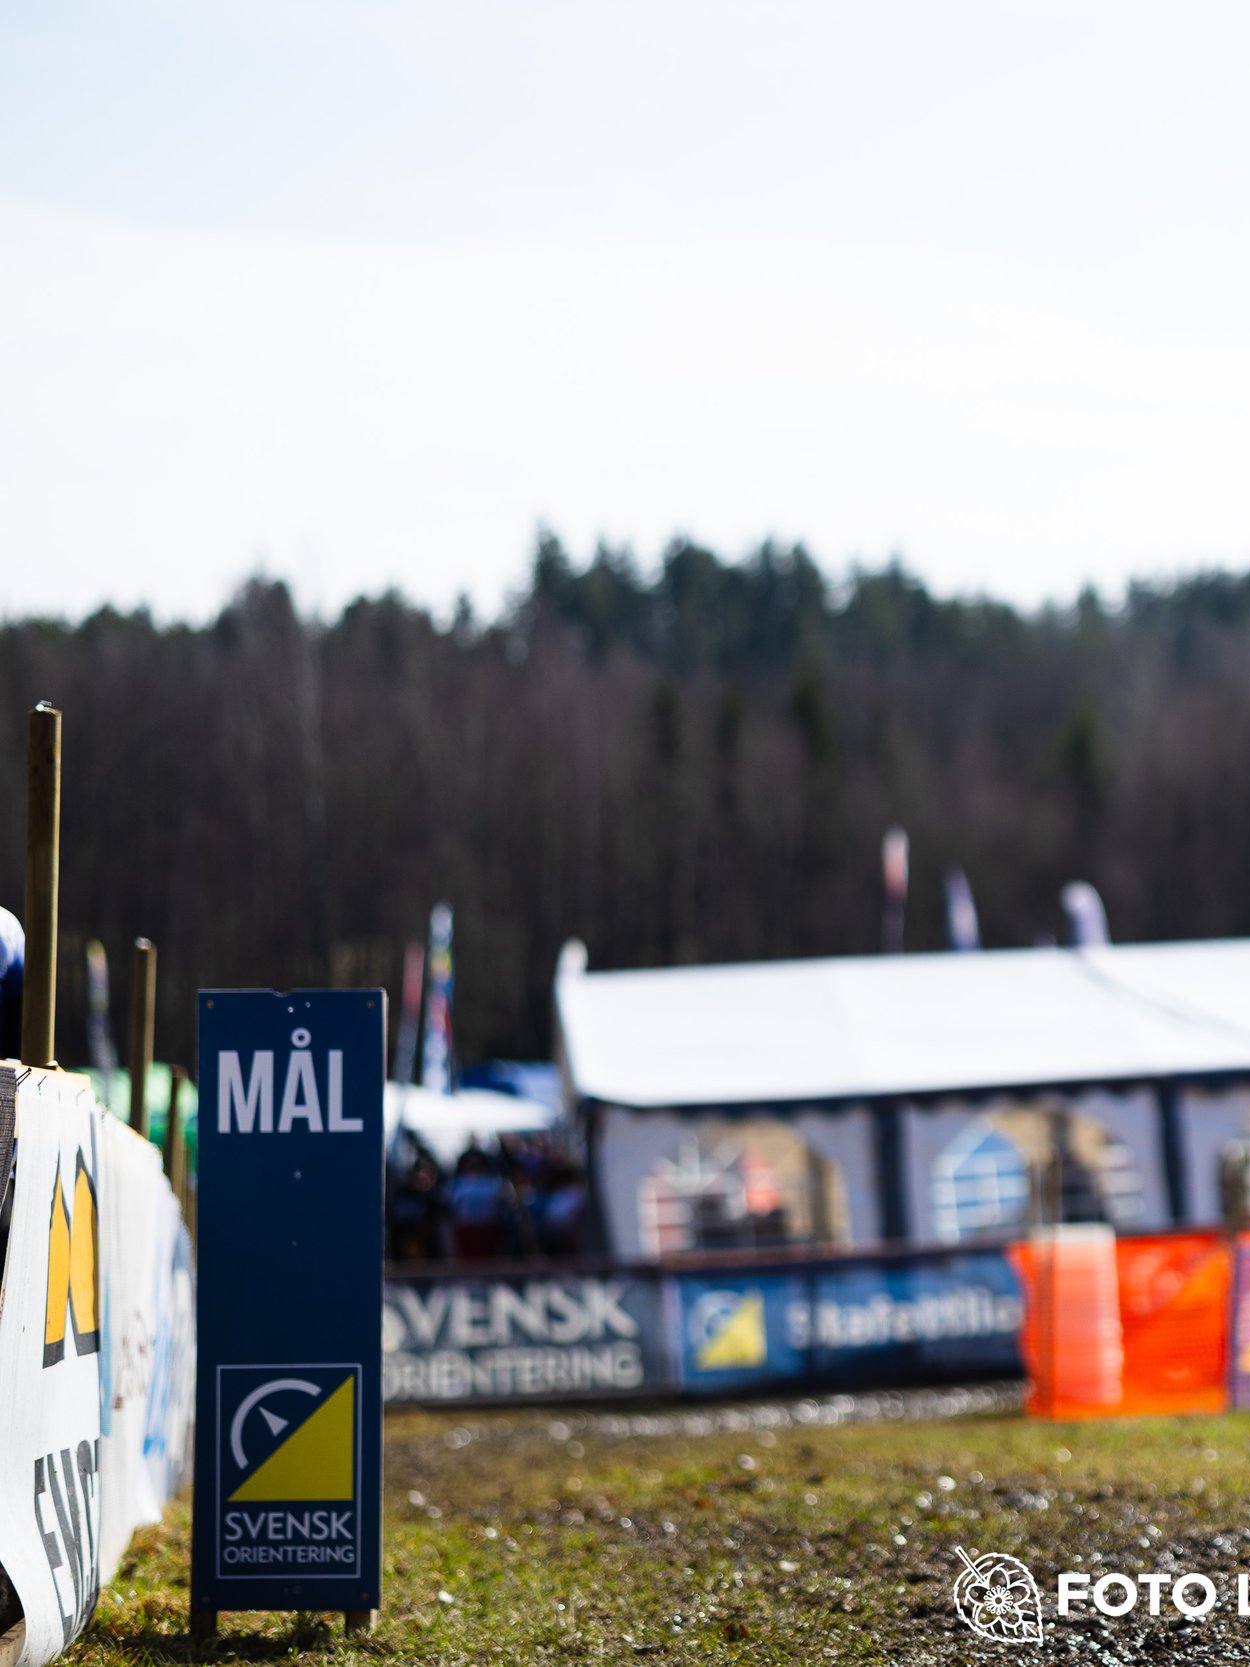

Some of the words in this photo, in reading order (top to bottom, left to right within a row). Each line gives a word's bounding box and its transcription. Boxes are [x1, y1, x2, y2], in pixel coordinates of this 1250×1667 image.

[217, 1027, 364, 1133] MÅL
[224, 1511, 354, 1541] SVENSK
[223, 1545, 355, 1564] ORIENTERING
